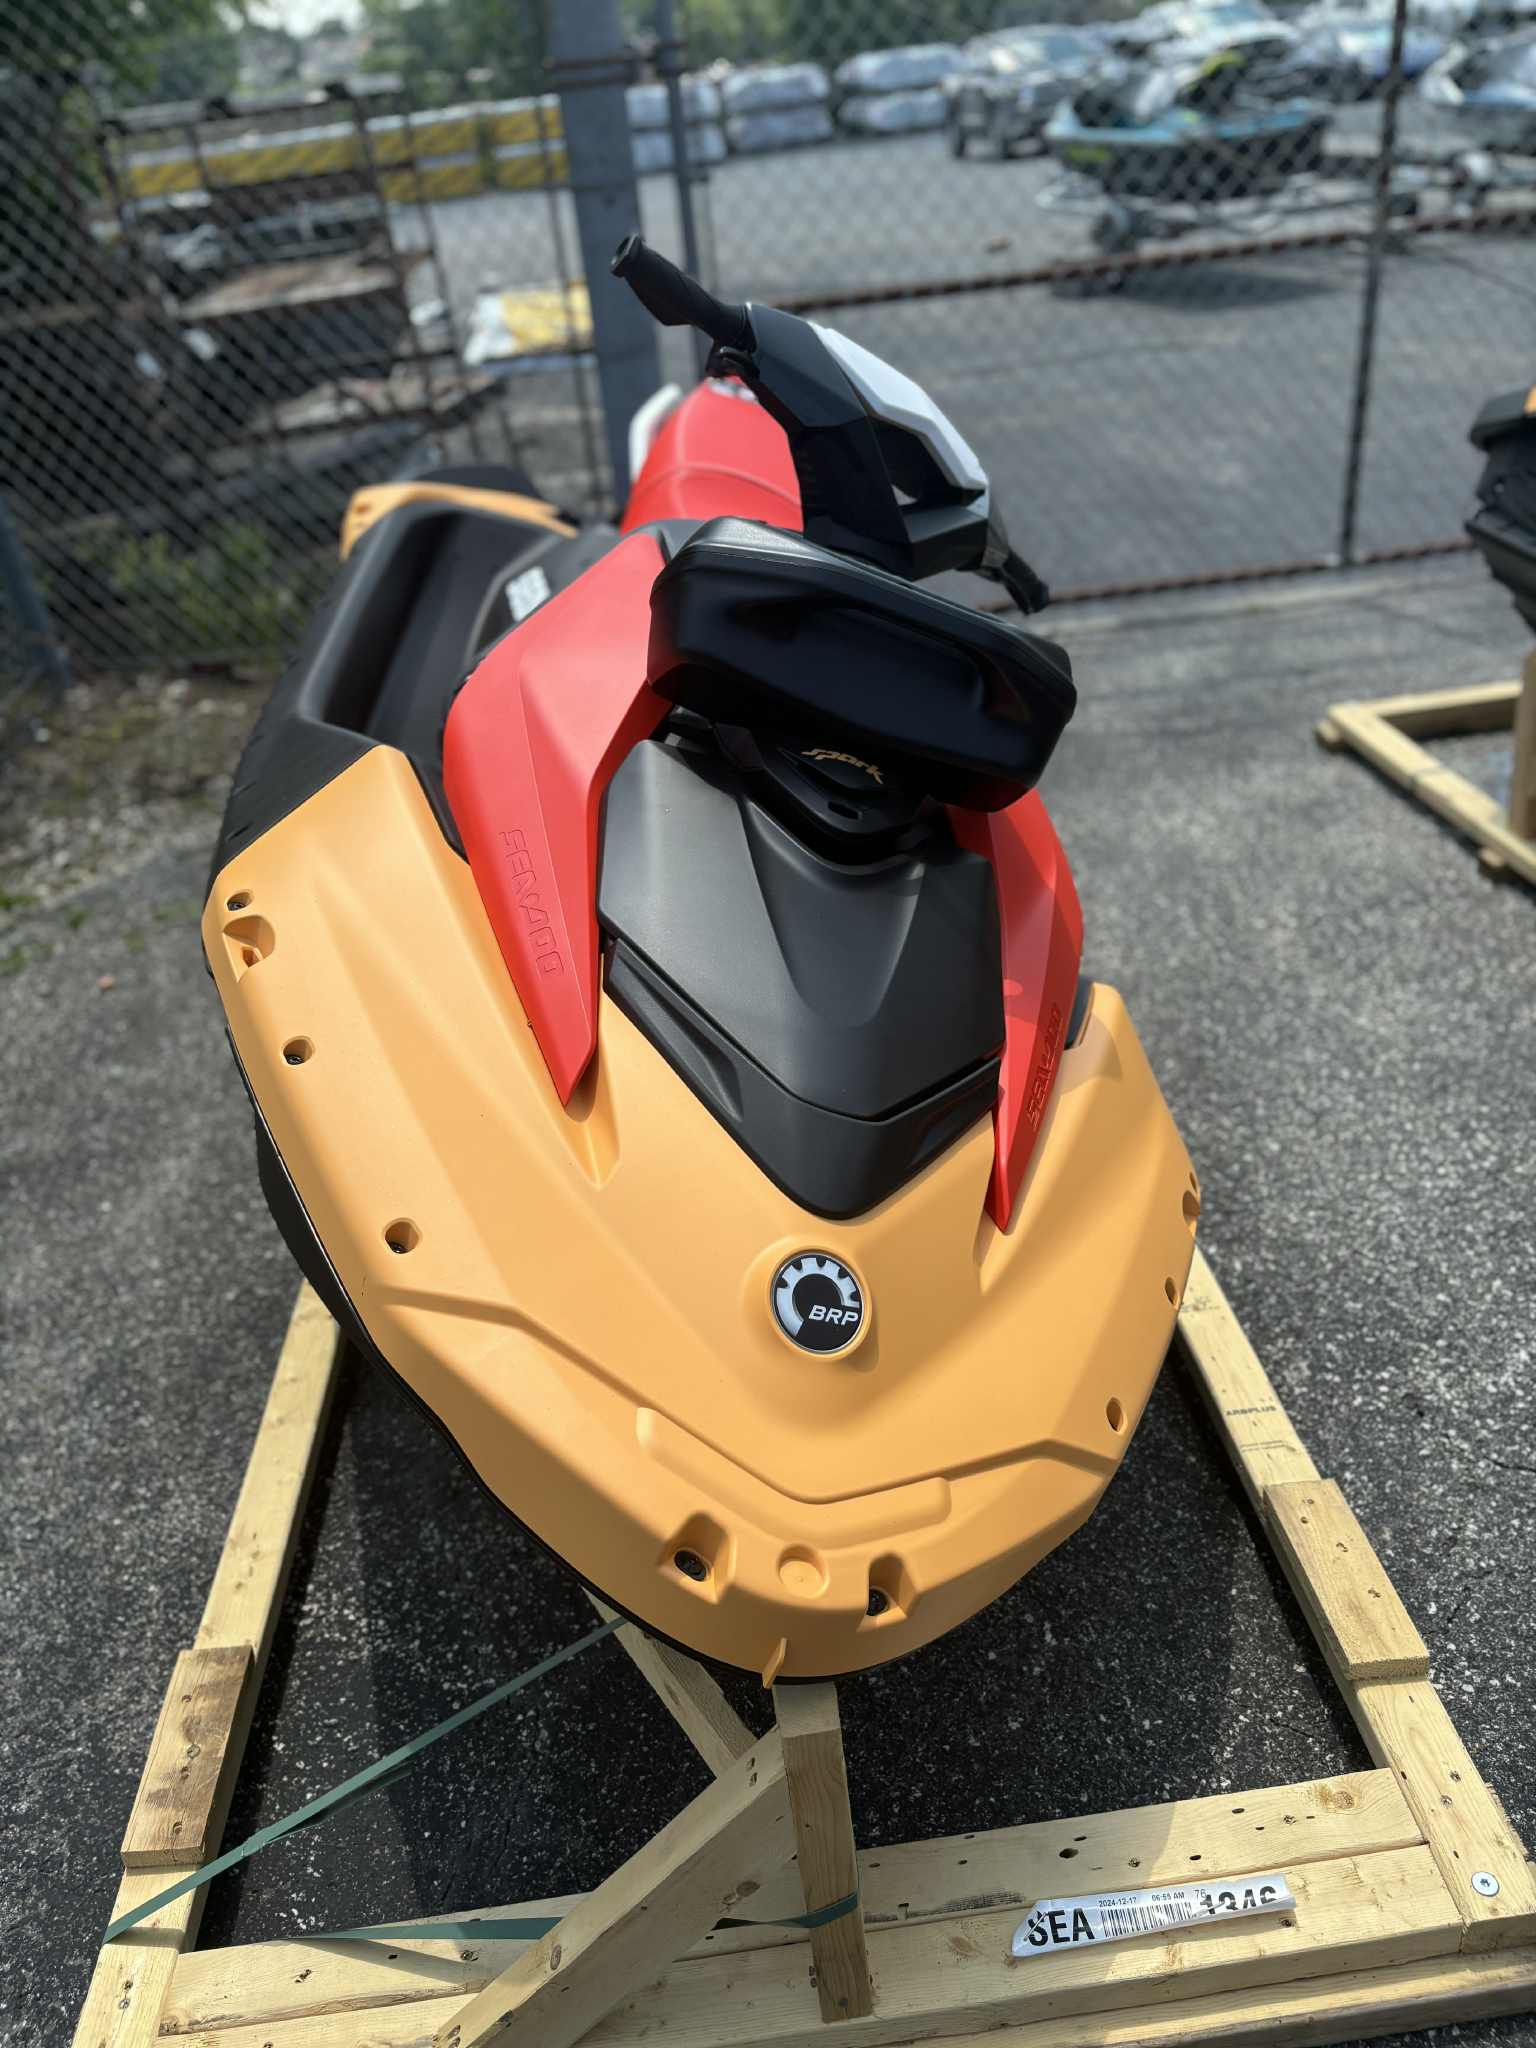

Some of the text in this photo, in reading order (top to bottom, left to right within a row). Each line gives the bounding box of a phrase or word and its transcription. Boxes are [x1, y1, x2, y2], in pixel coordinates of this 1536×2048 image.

[809, 1304, 860, 1326] BRP
[1098, 1896, 1138, 1908] 2024-12-17
[1173, 1891, 1186, 1900] AM
[1027, 1907, 1096, 1947] SEA
